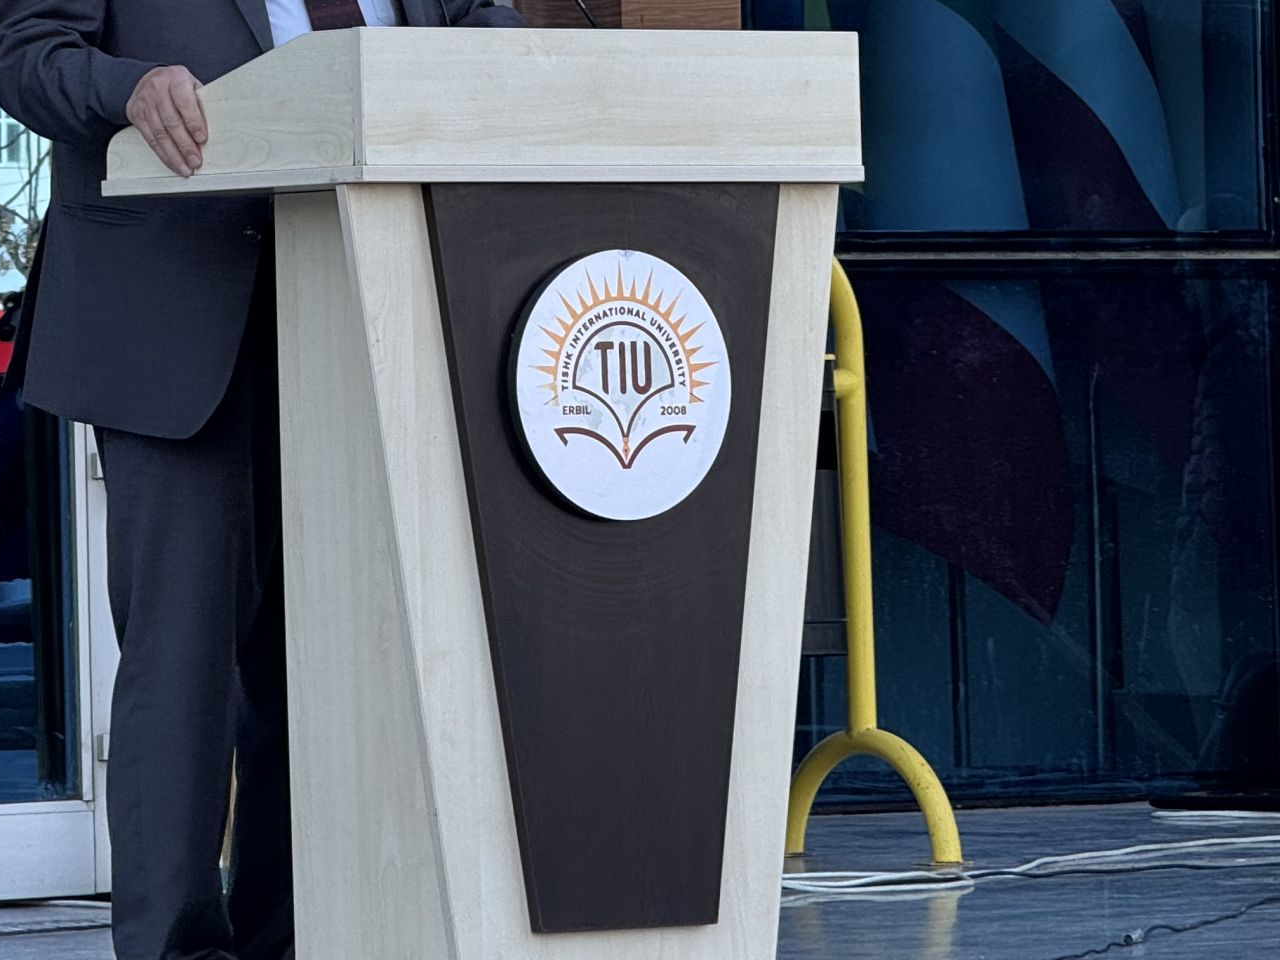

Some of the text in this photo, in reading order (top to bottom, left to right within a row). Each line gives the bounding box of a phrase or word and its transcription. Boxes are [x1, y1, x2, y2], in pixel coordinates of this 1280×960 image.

[561, 306, 687, 392] TISHK INTERNATIONAL UNIVERSITY
[593, 340, 653, 395] TIU
[562, 404, 592, 416] ERBIL
[660, 404, 687, 416] 2008
